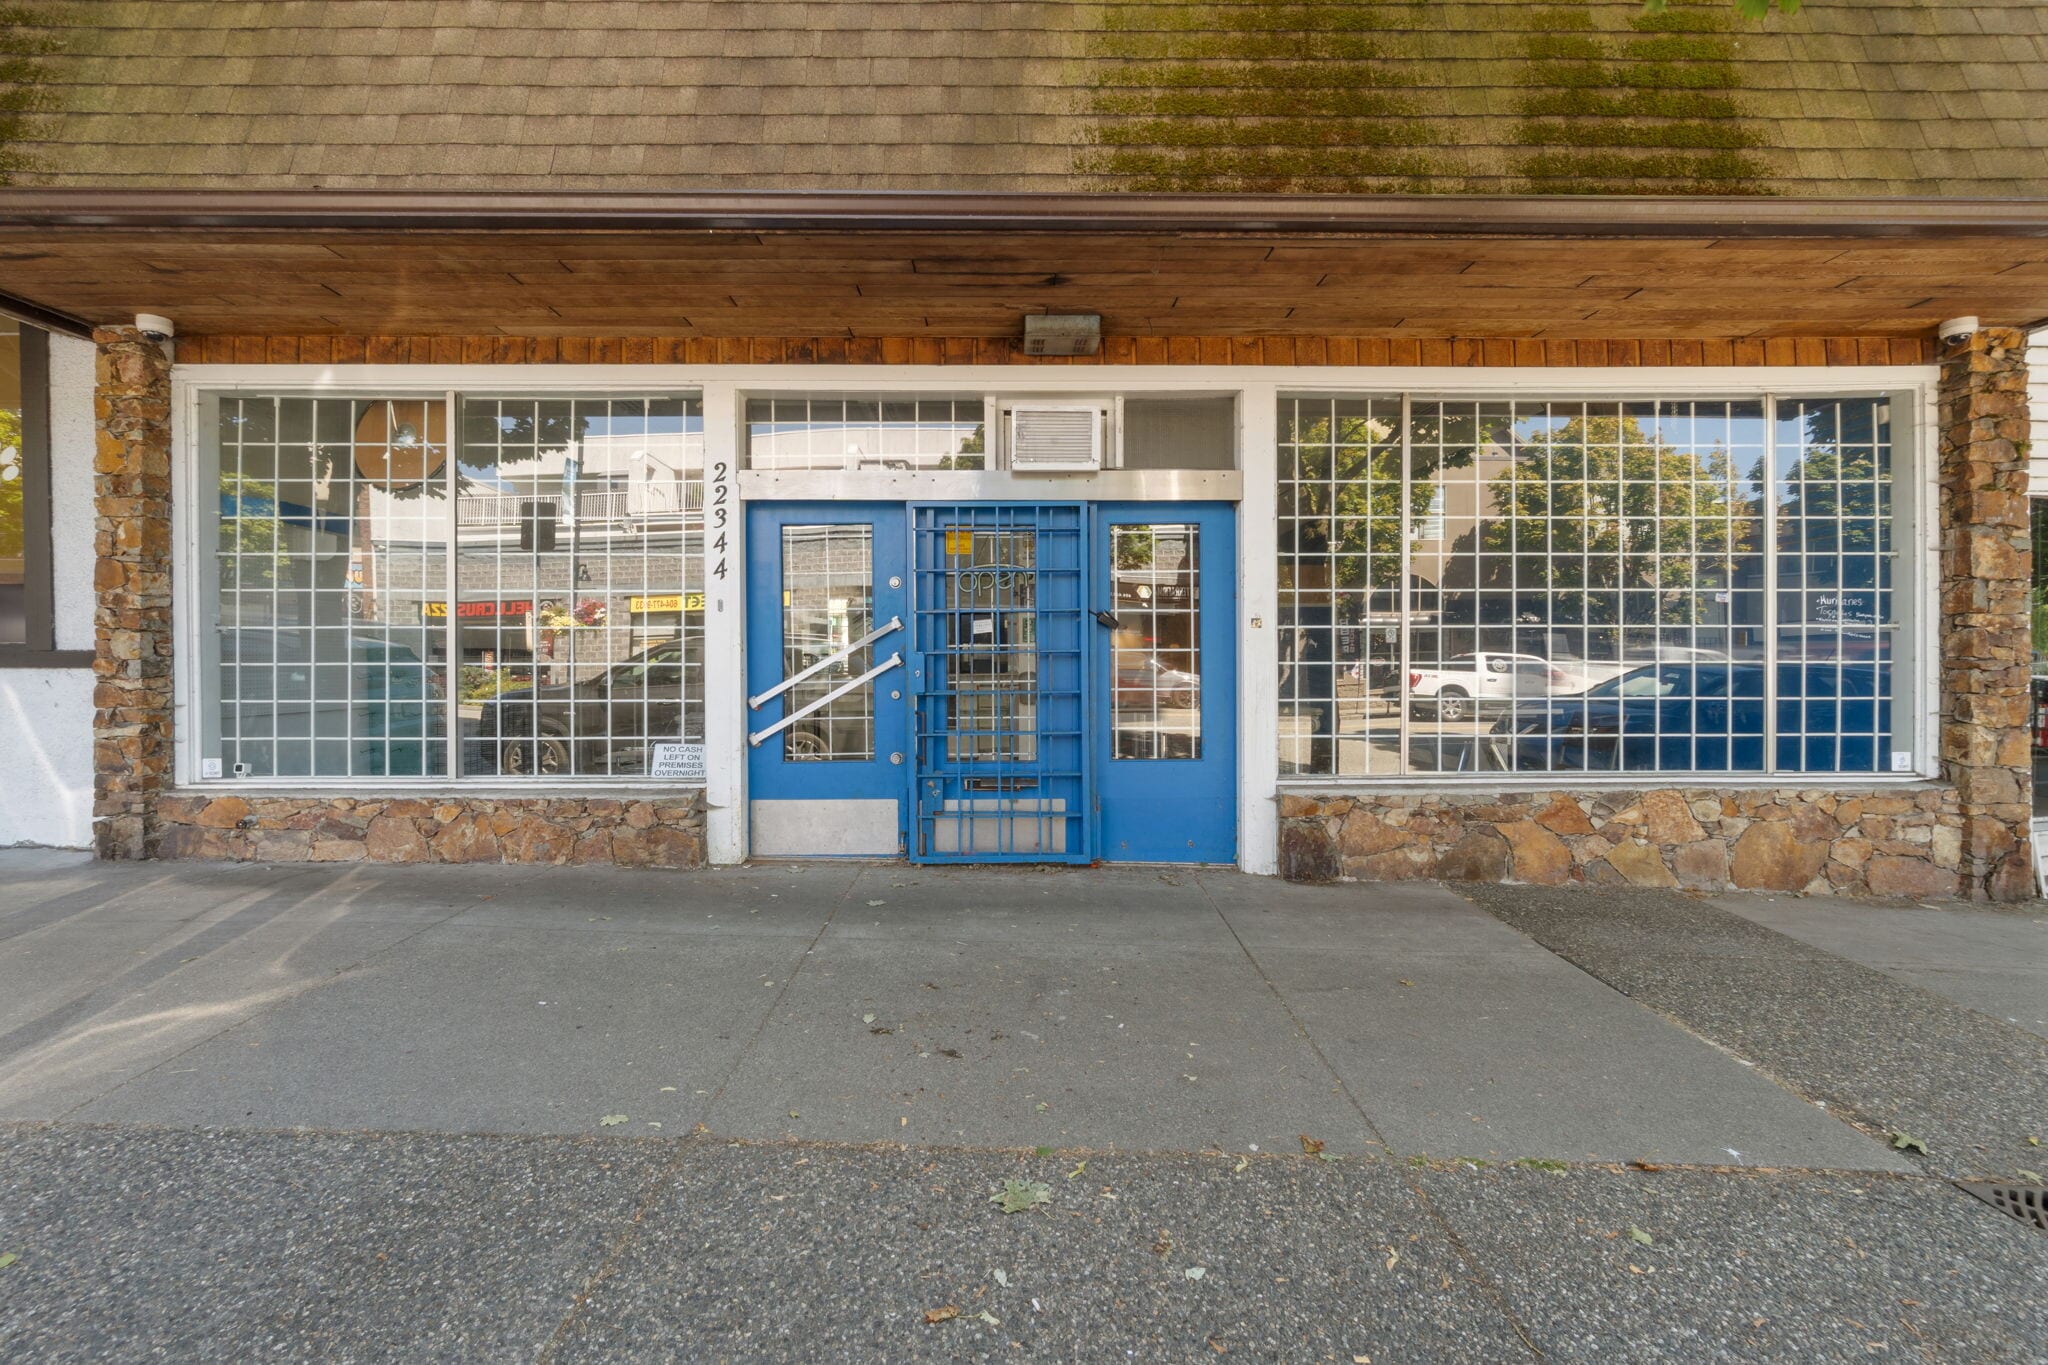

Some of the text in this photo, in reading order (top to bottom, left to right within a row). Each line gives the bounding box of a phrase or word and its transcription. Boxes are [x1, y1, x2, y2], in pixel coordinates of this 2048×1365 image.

[713, 462, 728, 580] 22344
[959, 571, 1028, 597] open
[663, 745, 677, 753] NO
[663, 753, 685, 761] LEFT
[658, 761, 704, 769] PREMISES
[654, 769, 706, 777] OVERNIGHT
